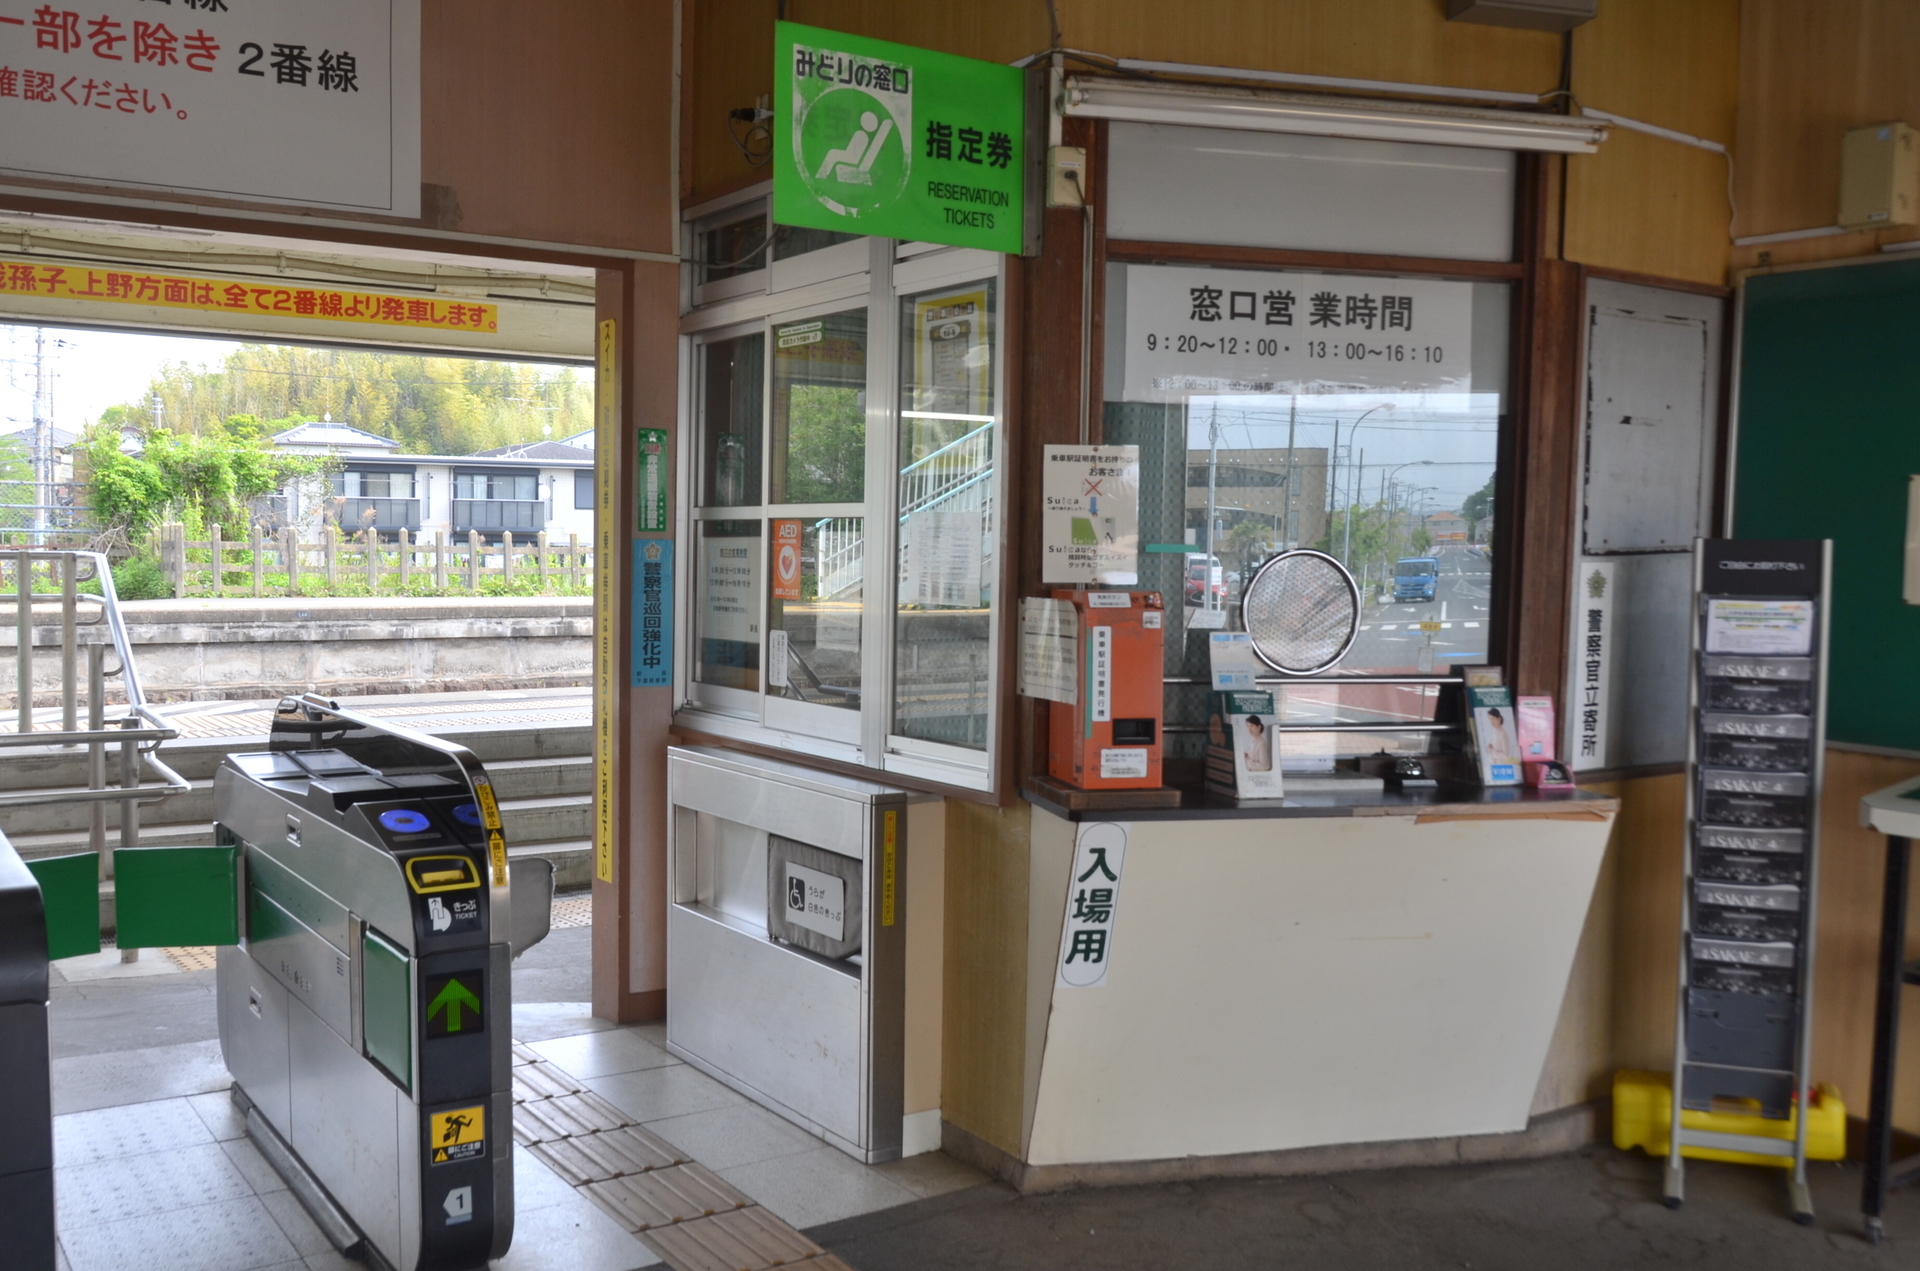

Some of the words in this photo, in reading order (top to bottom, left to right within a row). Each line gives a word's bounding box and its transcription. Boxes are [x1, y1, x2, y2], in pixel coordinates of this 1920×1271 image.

[238, 42, 359, 93] 2番線
[795, 50, 909, 95] みどりの窓口
[926, 121, 1013, 169] 指定券
[927, 181, 1009, 208] RESERVATION
[943, 208, 995, 230] TICKETS
[0, 263, 498, 331] 孫子、上野方面は、全て2番線より発車します。
[1189, 285, 1414, 332] 窓口営業時間
[779, 524, 797, 538] AED
[643, 562, 662, 669] 警察官巡回強化中
[1581, 608, 1603, 757] 警察官立寄所
[478, 785, 499, 827] かけこみ禁止
[453, 899, 477, 912] きっぷ
[808, 885, 826, 899] うらが
[1066, 847, 1118, 965] 入場用
[454, 911, 477, 920] TICKET
[808, 902, 842, 922] 白色のきっぷ
[453, 1150, 476, 1159] CAUTION
[456, 1193, 463, 1210] 1
